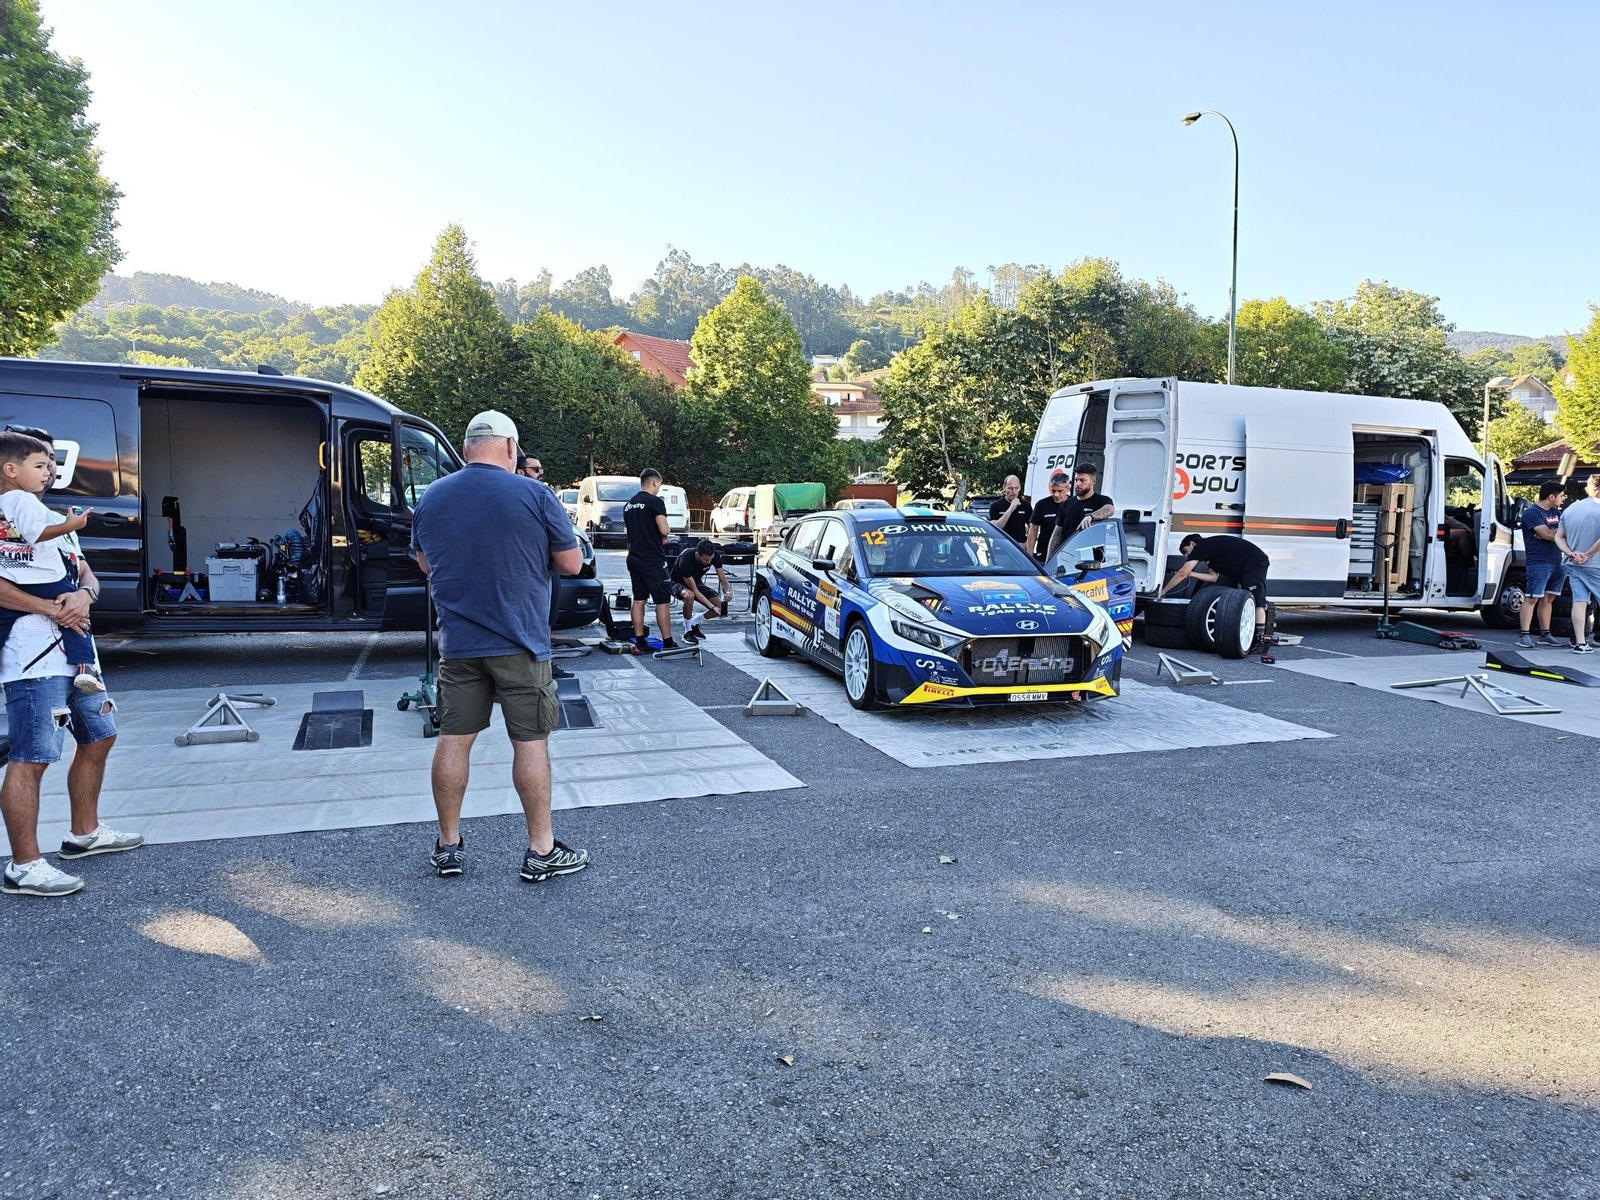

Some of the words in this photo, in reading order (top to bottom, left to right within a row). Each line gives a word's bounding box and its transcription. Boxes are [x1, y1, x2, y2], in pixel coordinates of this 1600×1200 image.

[1175, 453, 1246, 471] PORTS
[911, 524, 987, 534] HYUNDAI
[861, 531, 888, 546] 12
[788, 587, 817, 611] RALLYE
[789, 599, 801, 611] TEAM
[800, 606, 814, 619] SPAIN
[901, 606, 924, 621] HYUNDAI
[968, 603, 1058, 613] RALLYE
[1108, 603, 1131, 616] RTS
[923, 684, 955, 697] PIRELLI
